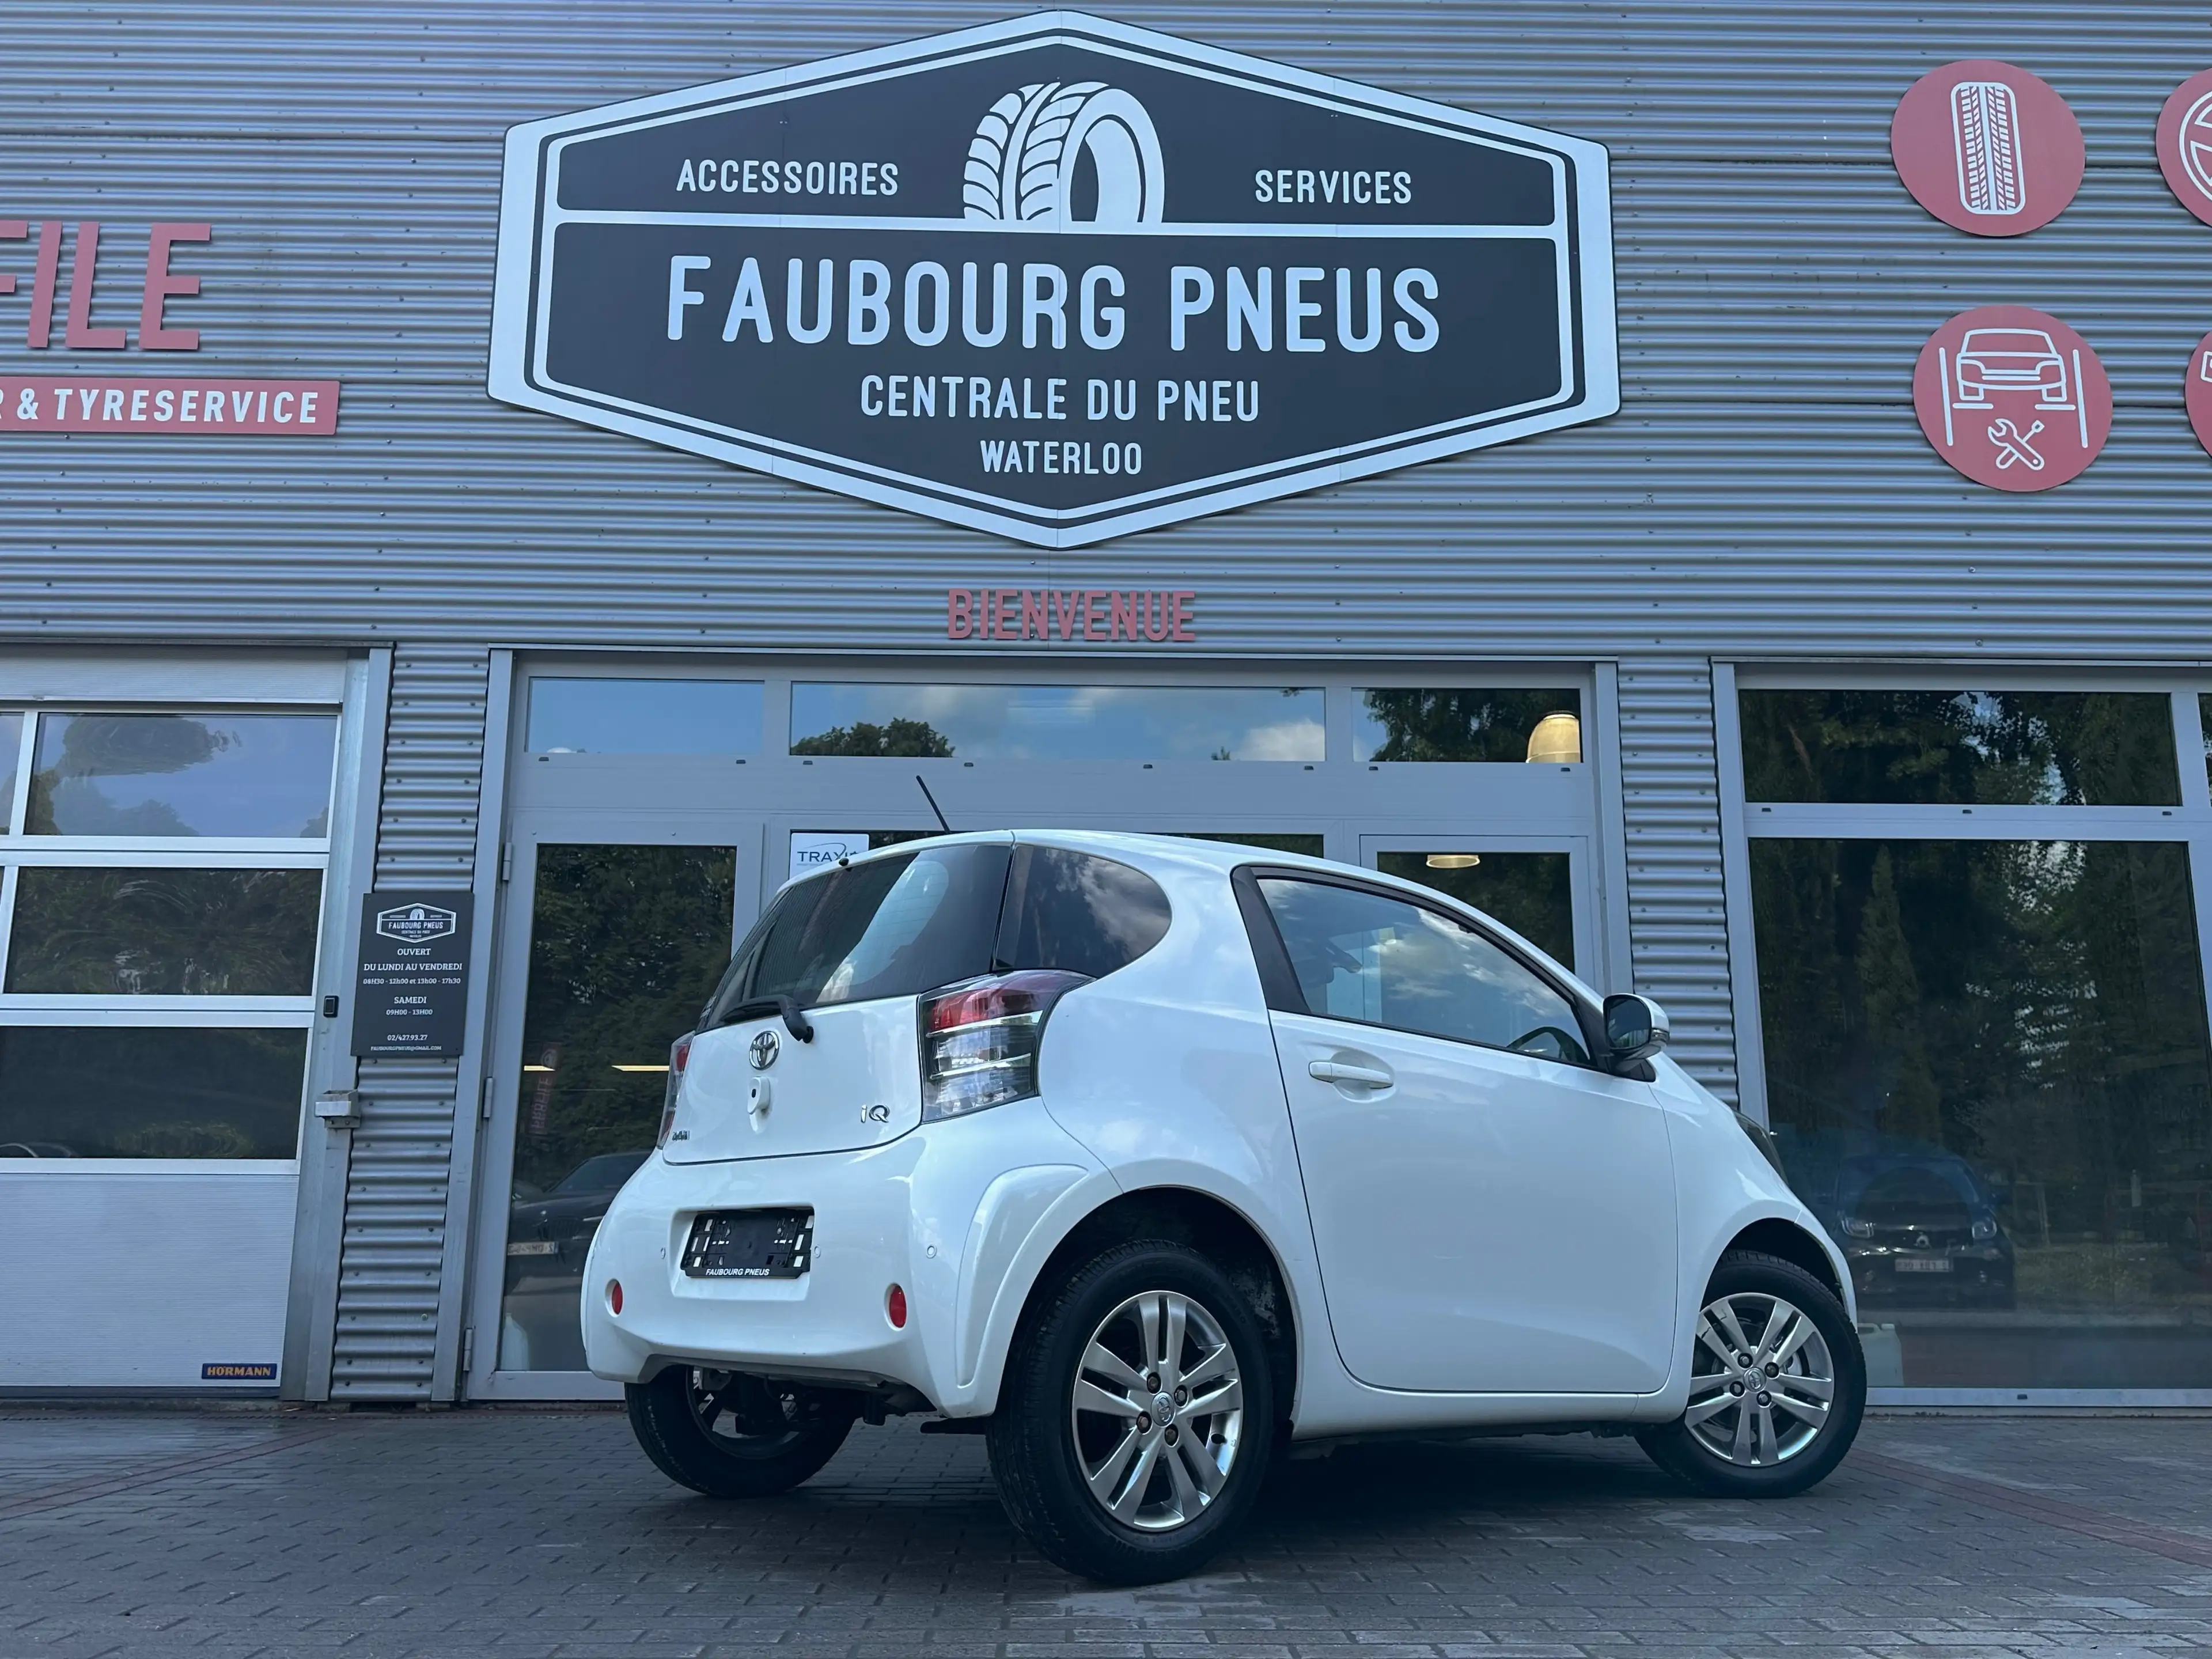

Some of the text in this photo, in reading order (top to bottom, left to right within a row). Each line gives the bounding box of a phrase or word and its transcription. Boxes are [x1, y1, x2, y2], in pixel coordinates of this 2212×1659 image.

[676, 159, 898, 196] ACCESSOIRES
[1255, 169, 1412, 204] SERVICES
[668, 255, 1440, 353] FAUBOURG PNEUS
[17, 388, 39, 419] &
[54, 389, 319, 423] TYRESERVICE
[861, 374, 1259, 422] CENTRALE DU PNEU
[980, 440, 1142, 475] WATERLOO
[946, 589, 1196, 642] BIENVENUE
[388, 921, 422, 929] FAUBOURG
[419, 963, 463, 971] VENDREDI
[394, 996, 427, 1004] SAMEDI
[705, 1268, 771, 1276] FAUBOURG PNEUS
